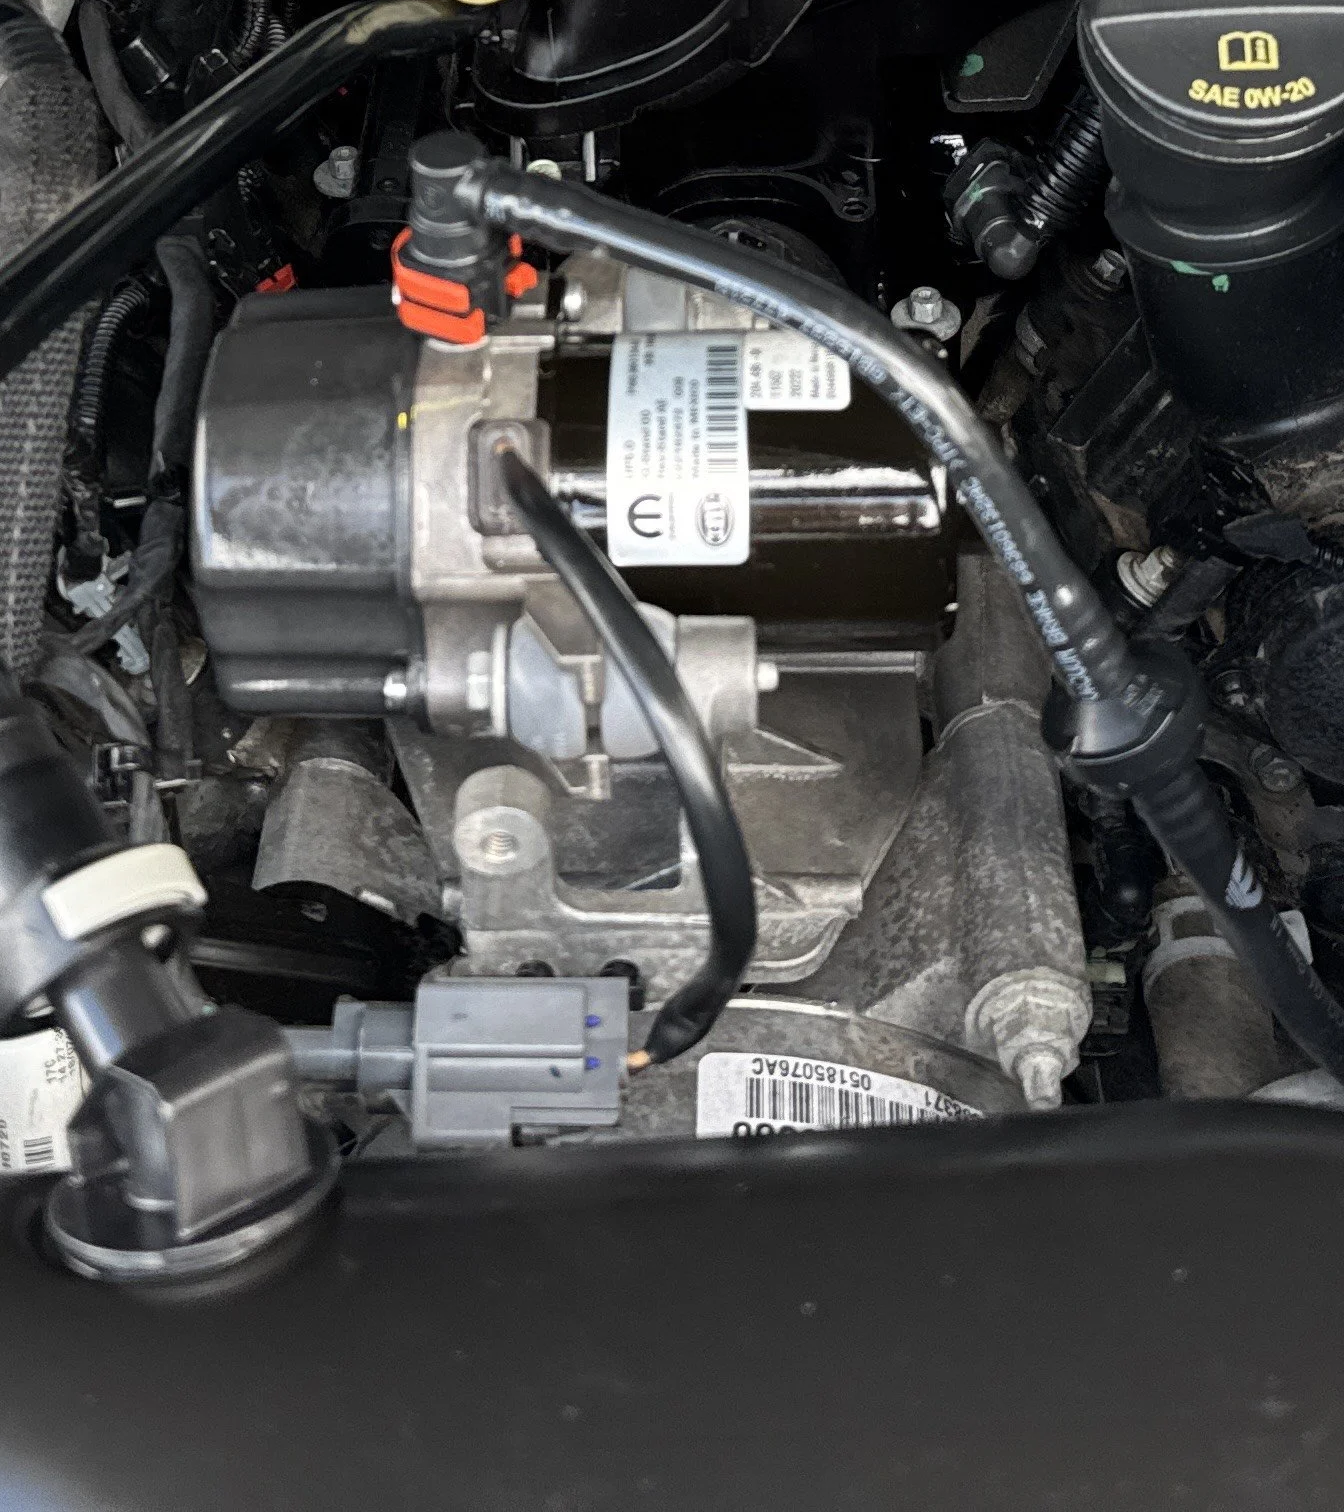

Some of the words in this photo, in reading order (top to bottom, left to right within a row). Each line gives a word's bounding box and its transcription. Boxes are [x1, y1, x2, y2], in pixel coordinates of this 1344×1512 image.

[1188, 79, 1240, 109] SAE
[1244, 77, 1316, 109] 0W-20
[751, 1056, 873, 1092] 05185076AC
